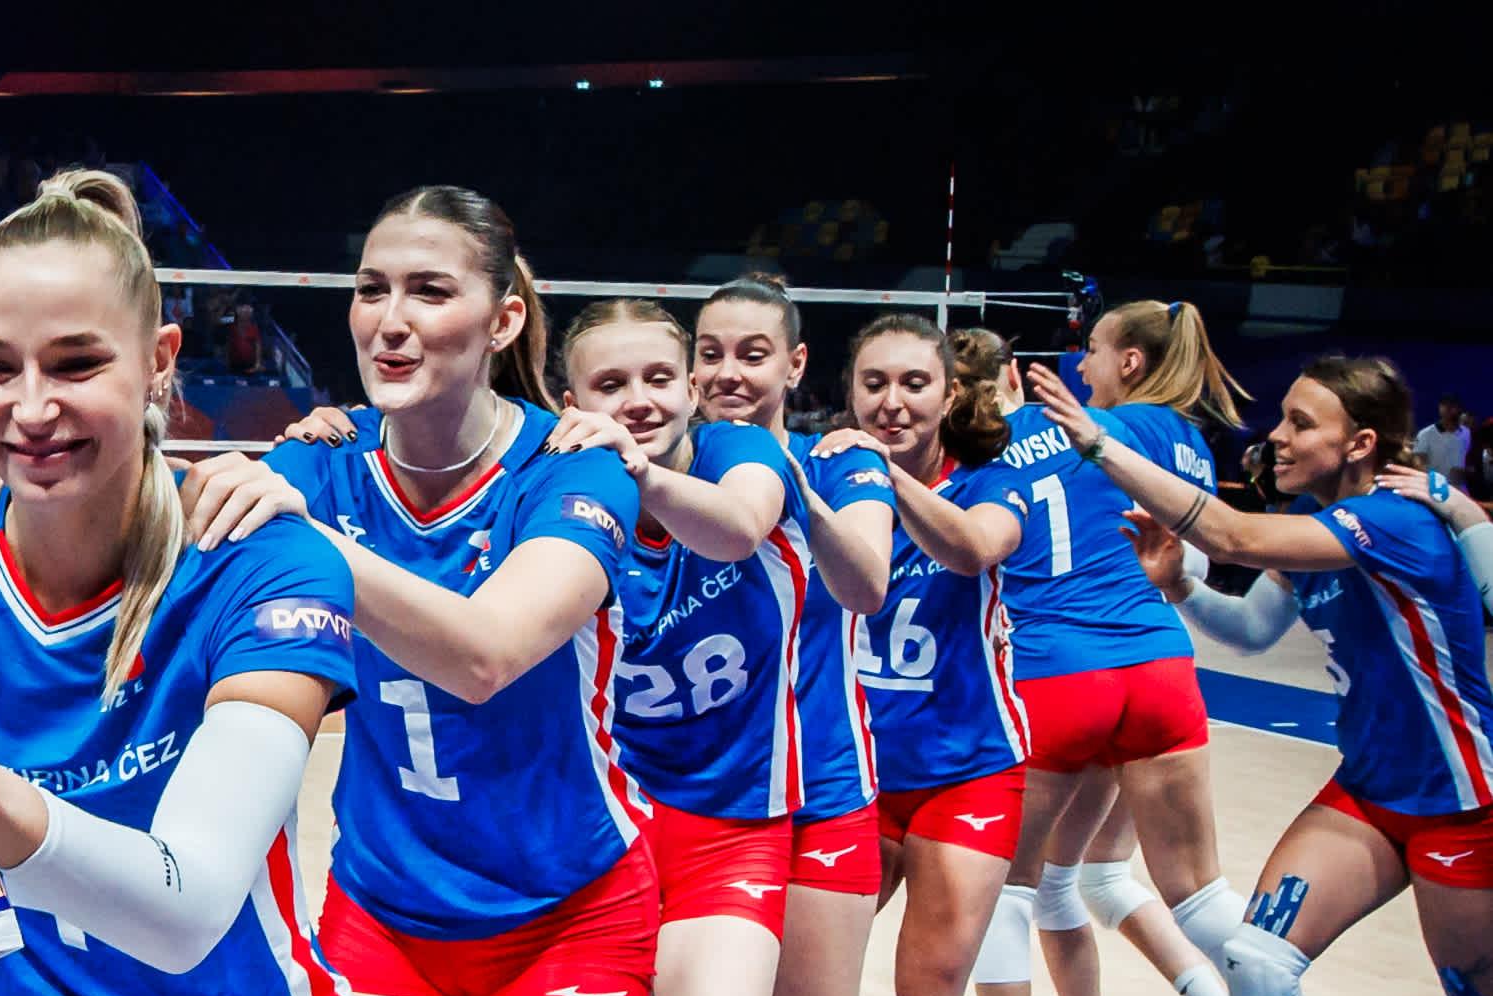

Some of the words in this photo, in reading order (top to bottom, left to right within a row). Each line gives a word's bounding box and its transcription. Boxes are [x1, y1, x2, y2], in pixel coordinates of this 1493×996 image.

[1031, 473, 1073, 577] 1
[700, 562, 742, 599] ČEZ
[272, 607, 352, 641] DATART
[615, 633, 749, 718] 28
[118, 731, 180, 783] ČEZ
[378, 678, 460, 802] 1
